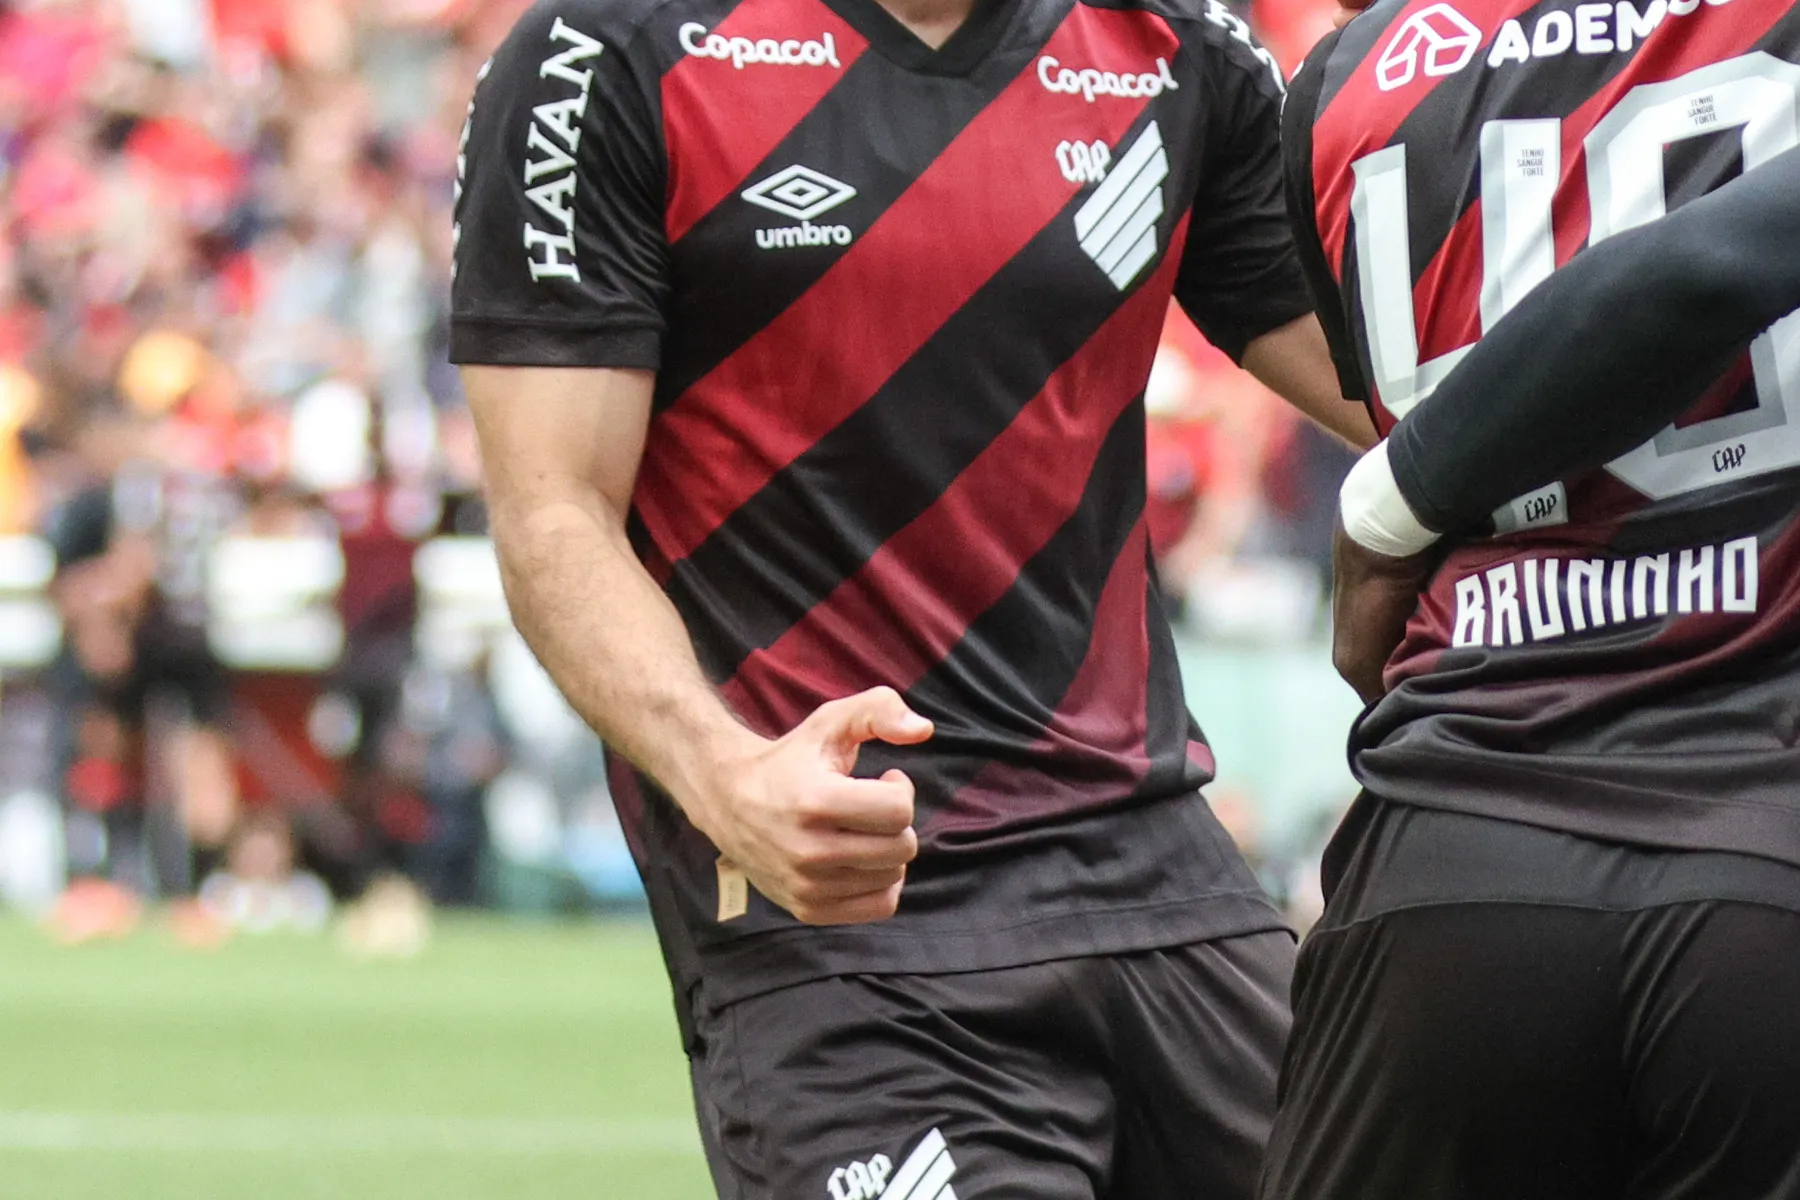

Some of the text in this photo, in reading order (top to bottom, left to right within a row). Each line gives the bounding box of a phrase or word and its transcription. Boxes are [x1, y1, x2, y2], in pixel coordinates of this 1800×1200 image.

[678, 21, 841, 70] Copacol
[1037, 55, 1179, 102] Copacol
[524, 16, 604, 283] HAVAN
[1055, 139, 1112, 182] CAP
[755, 220, 853, 248] umbro
[1712, 443, 1747, 473] CAP
[1524, 493, 1558, 523] CAP
[1452, 536, 1758, 648] BRUNINHO
